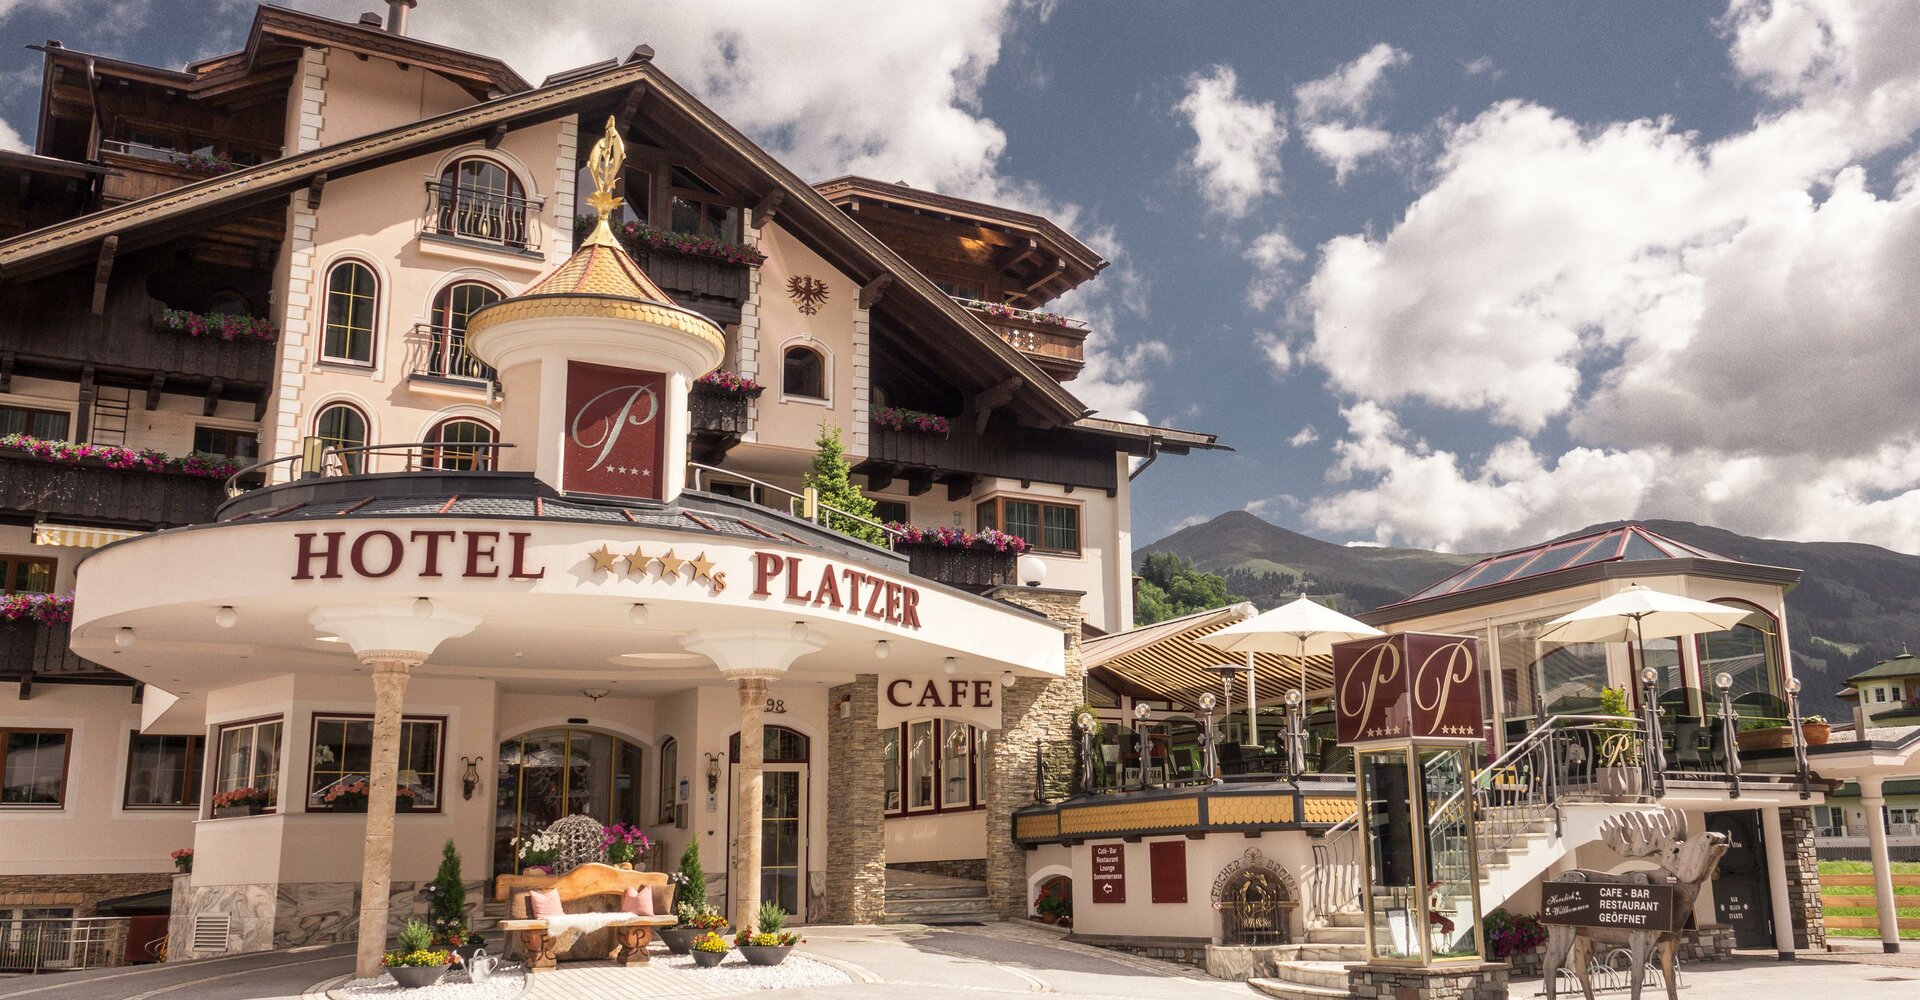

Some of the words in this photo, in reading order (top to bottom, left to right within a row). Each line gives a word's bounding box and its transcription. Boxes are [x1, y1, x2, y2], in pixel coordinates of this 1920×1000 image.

[291, 530, 545, 580] HOTEL
[753, 551, 922, 628] PLATZER
[886, 679, 994, 708] CAFE
[1099, 864, 1116, 873] Lounge
[1546, 891, 1575, 906] Herzlich
[1599, 887, 1622, 897] CAFE
[1631, 889, 1650, 899] BAR
[1552, 904, 1590, 917] Willkommen
[1599, 900, 1659, 912] RESTAURANT
[1598, 911, 1647, 925] GEÖFFNET
